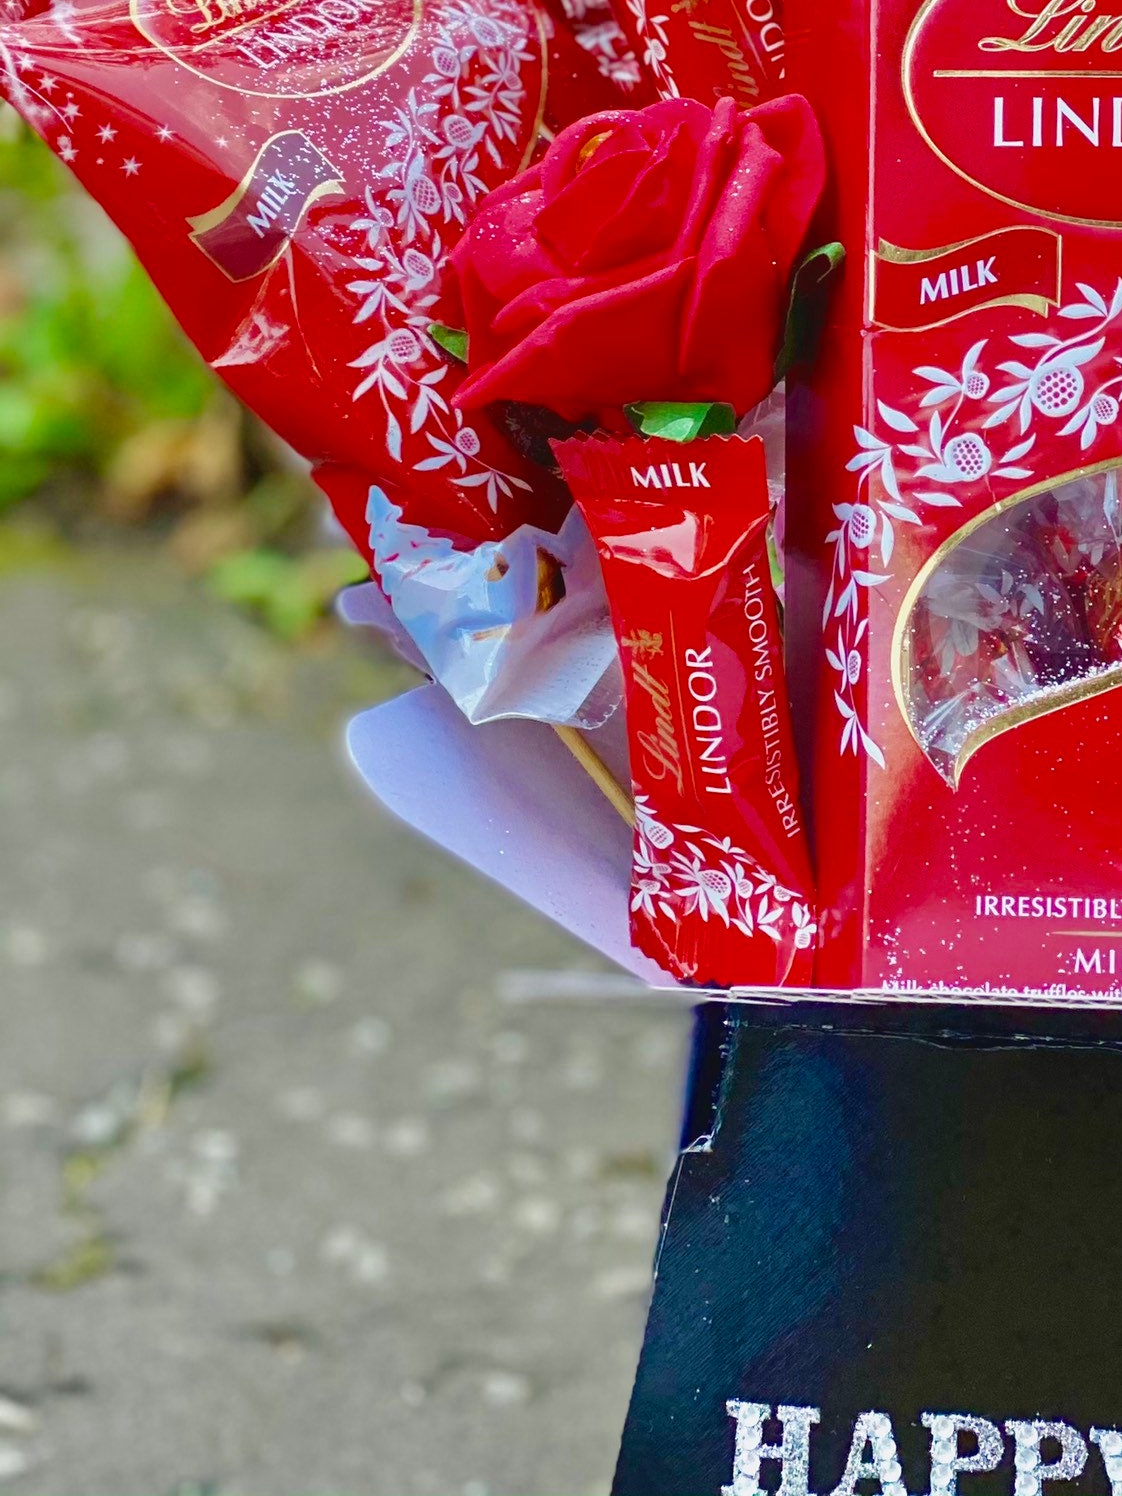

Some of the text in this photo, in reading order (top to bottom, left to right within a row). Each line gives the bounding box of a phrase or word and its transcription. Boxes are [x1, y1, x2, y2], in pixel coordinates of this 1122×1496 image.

[247, 168, 297, 239] MILK
[919, 256, 998, 305] MILK
[630, 461, 712, 489] MILK
[633, 656, 685, 798] Lindt
[685, 647, 732, 795] LINDOR
[742, 563, 801, 839] IRRESISTIBLY SMOOTH
